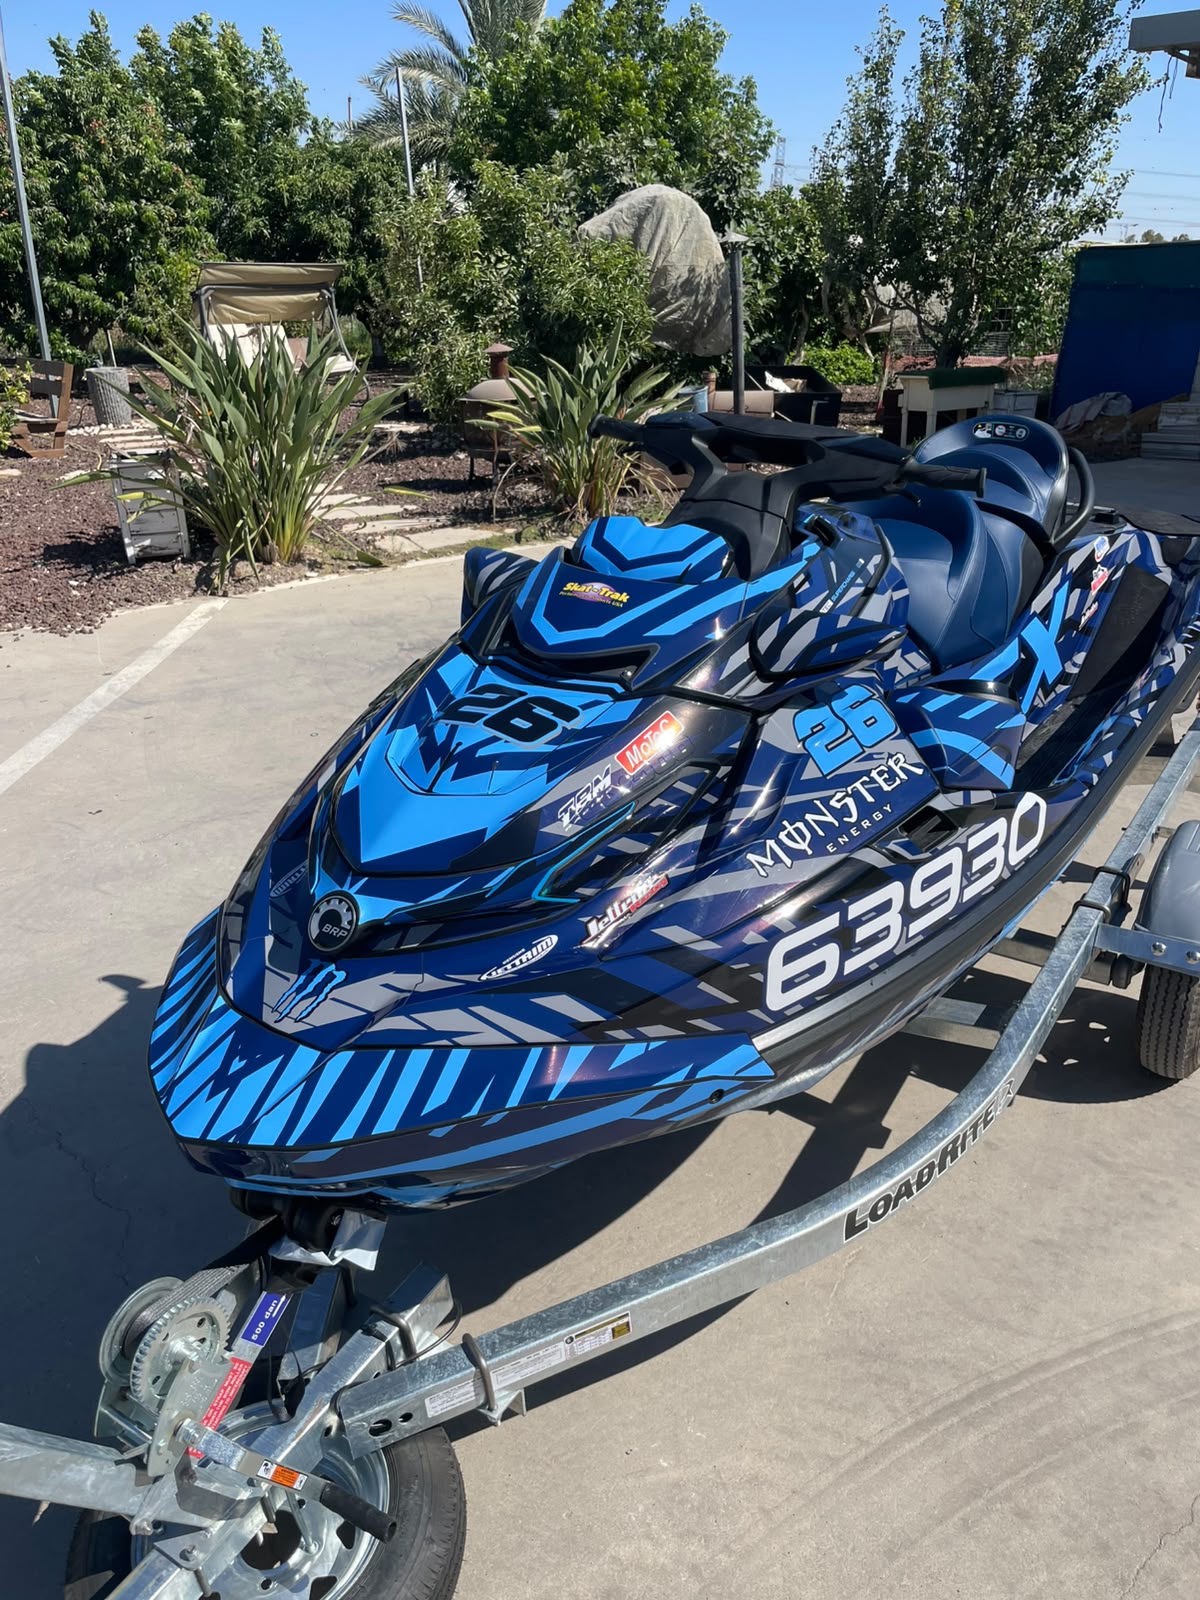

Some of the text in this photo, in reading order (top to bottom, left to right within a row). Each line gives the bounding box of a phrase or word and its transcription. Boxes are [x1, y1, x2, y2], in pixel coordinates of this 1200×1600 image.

[436, 683, 582, 750] 26
[793, 684, 897, 777] 26
[745, 752, 924, 877] MONSTER
[826, 803, 893, 854] ENERGY
[321, 923, 349, 938] BRP
[765, 792, 1047, 1011] 63930
[251, 1300, 278, 1340] 500 dan
